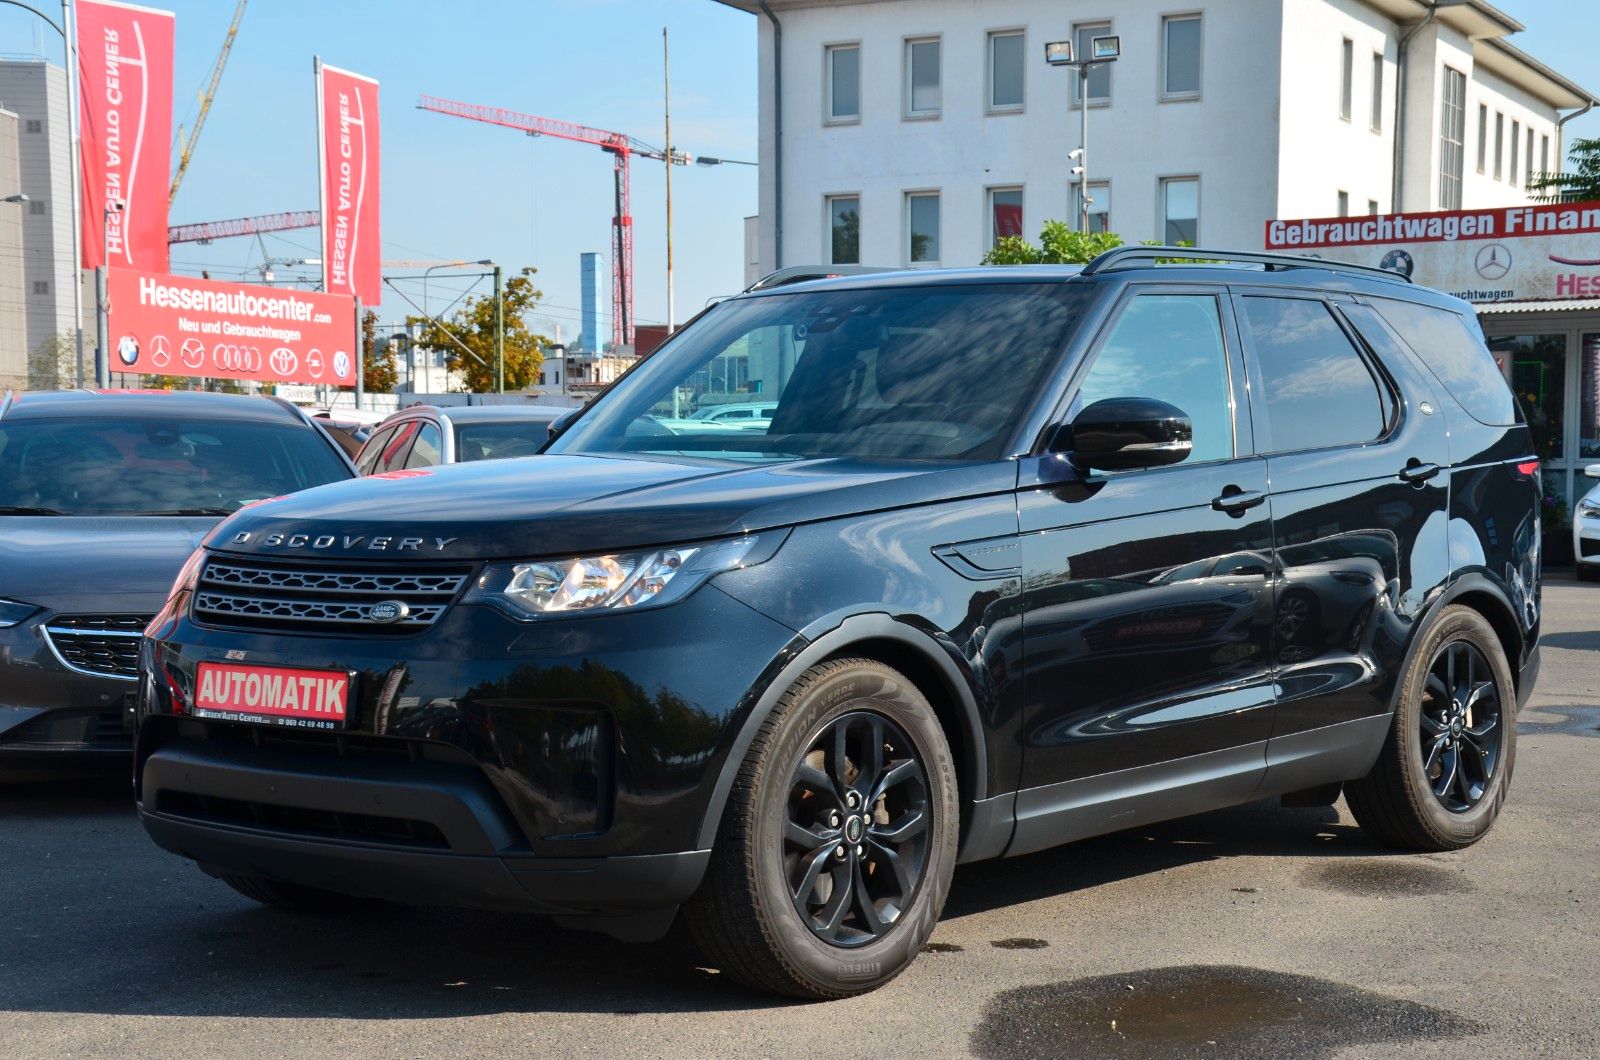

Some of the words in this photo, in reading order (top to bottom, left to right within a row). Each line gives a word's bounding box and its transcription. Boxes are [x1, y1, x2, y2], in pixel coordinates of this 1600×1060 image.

[1268, 214, 1494, 246] Gebrauchtwagen
[1504, 208, 1600, 233] Finan
[139, 277, 332, 324] Hessenautocenter.com
[1556, 273, 1600, 296] HES
[178, 317, 200, 332] Neu
[201, 320, 221, 335] und
[222, 322, 301, 343] Gebrauchtwagen
[233, 531, 459, 551] DISCOVERY
[198, 670, 346, 713] AUTOMATIK
